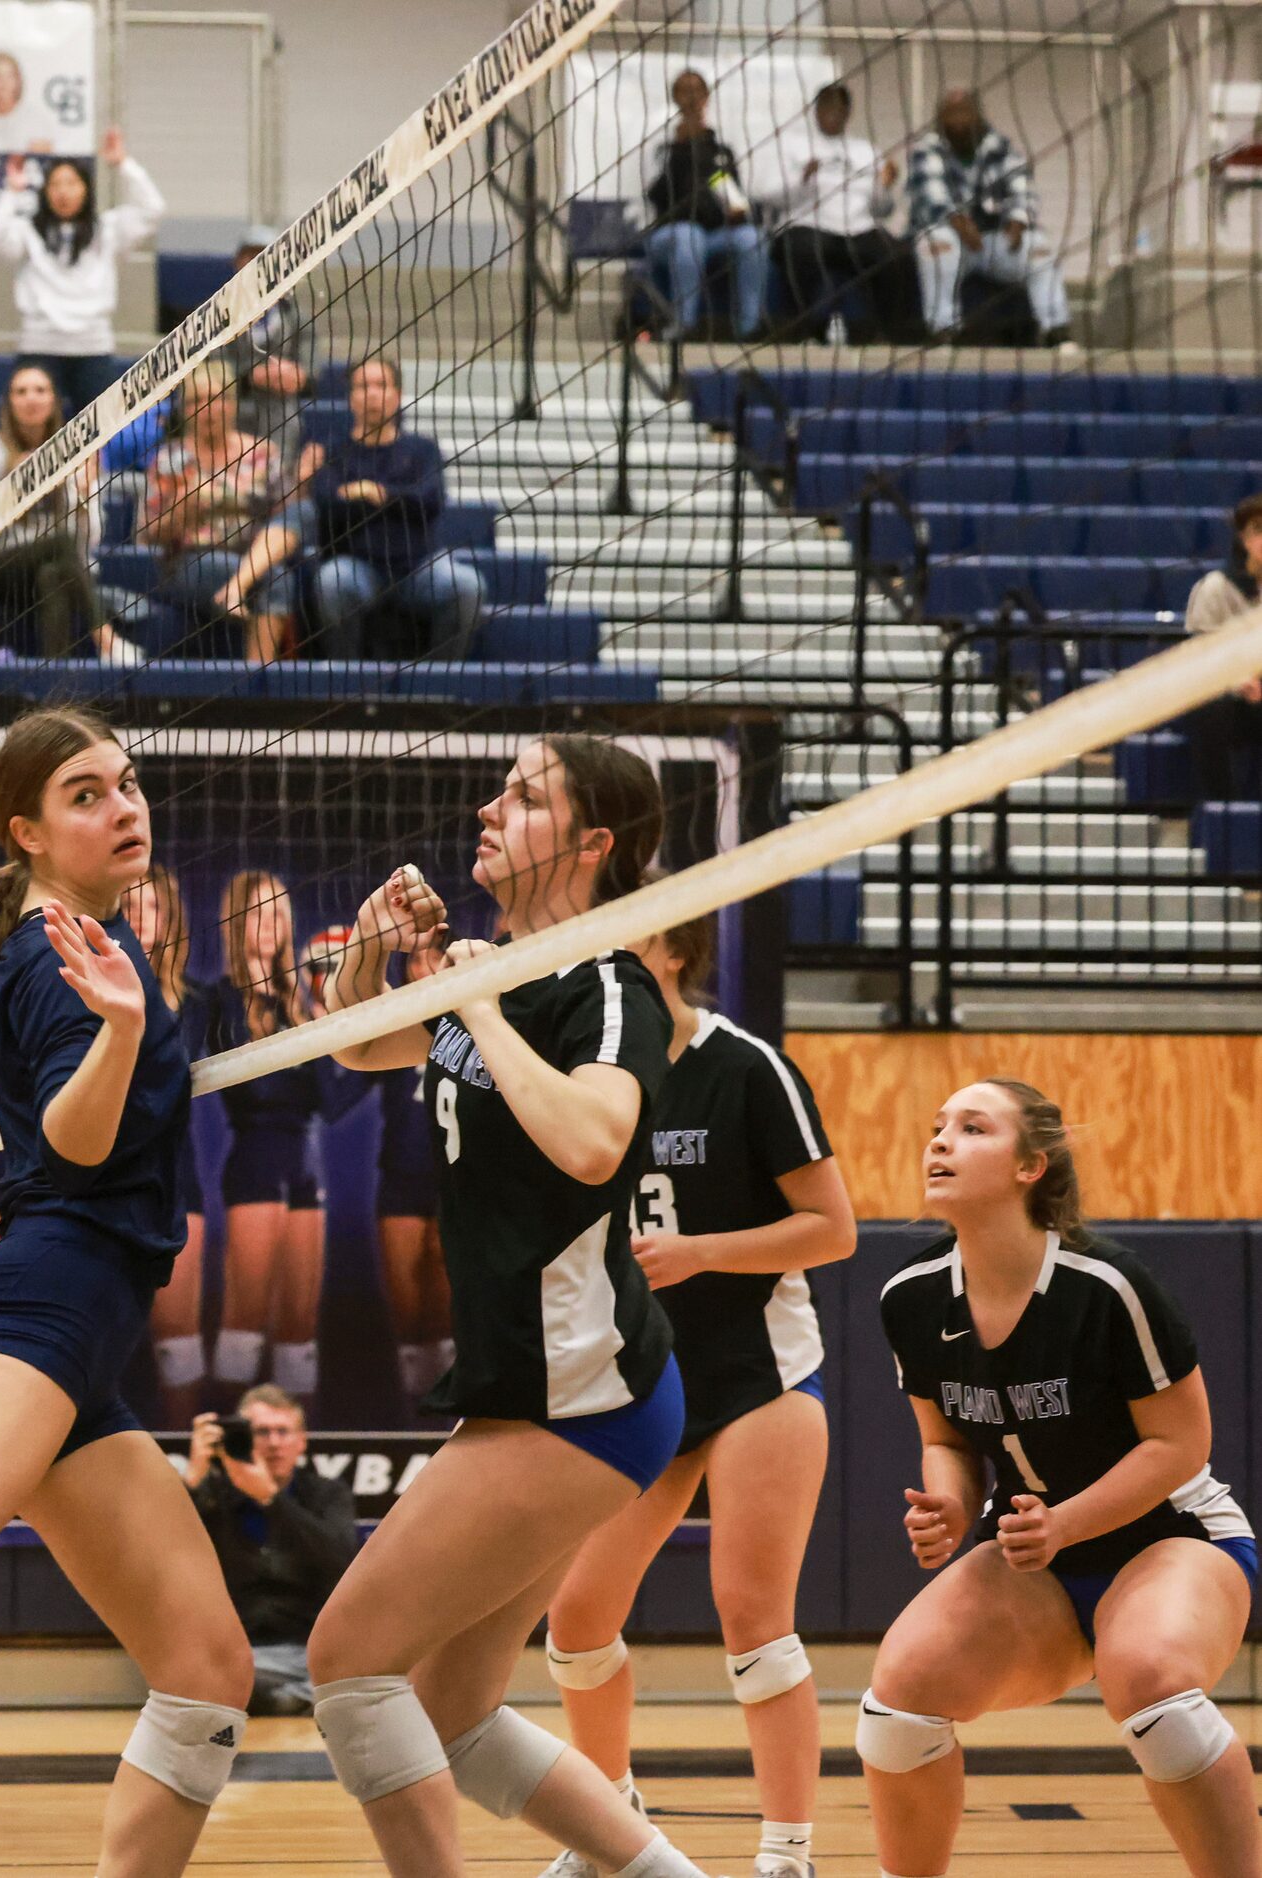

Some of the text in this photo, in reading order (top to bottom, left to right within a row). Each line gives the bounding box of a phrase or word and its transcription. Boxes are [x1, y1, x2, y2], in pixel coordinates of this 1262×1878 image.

[436, 1077, 461, 1165] 9
[652, 1129, 708, 1165] WEST
[941, 1377, 1071, 1425] PLANO WEST
[1002, 1434, 1049, 1492] 1
